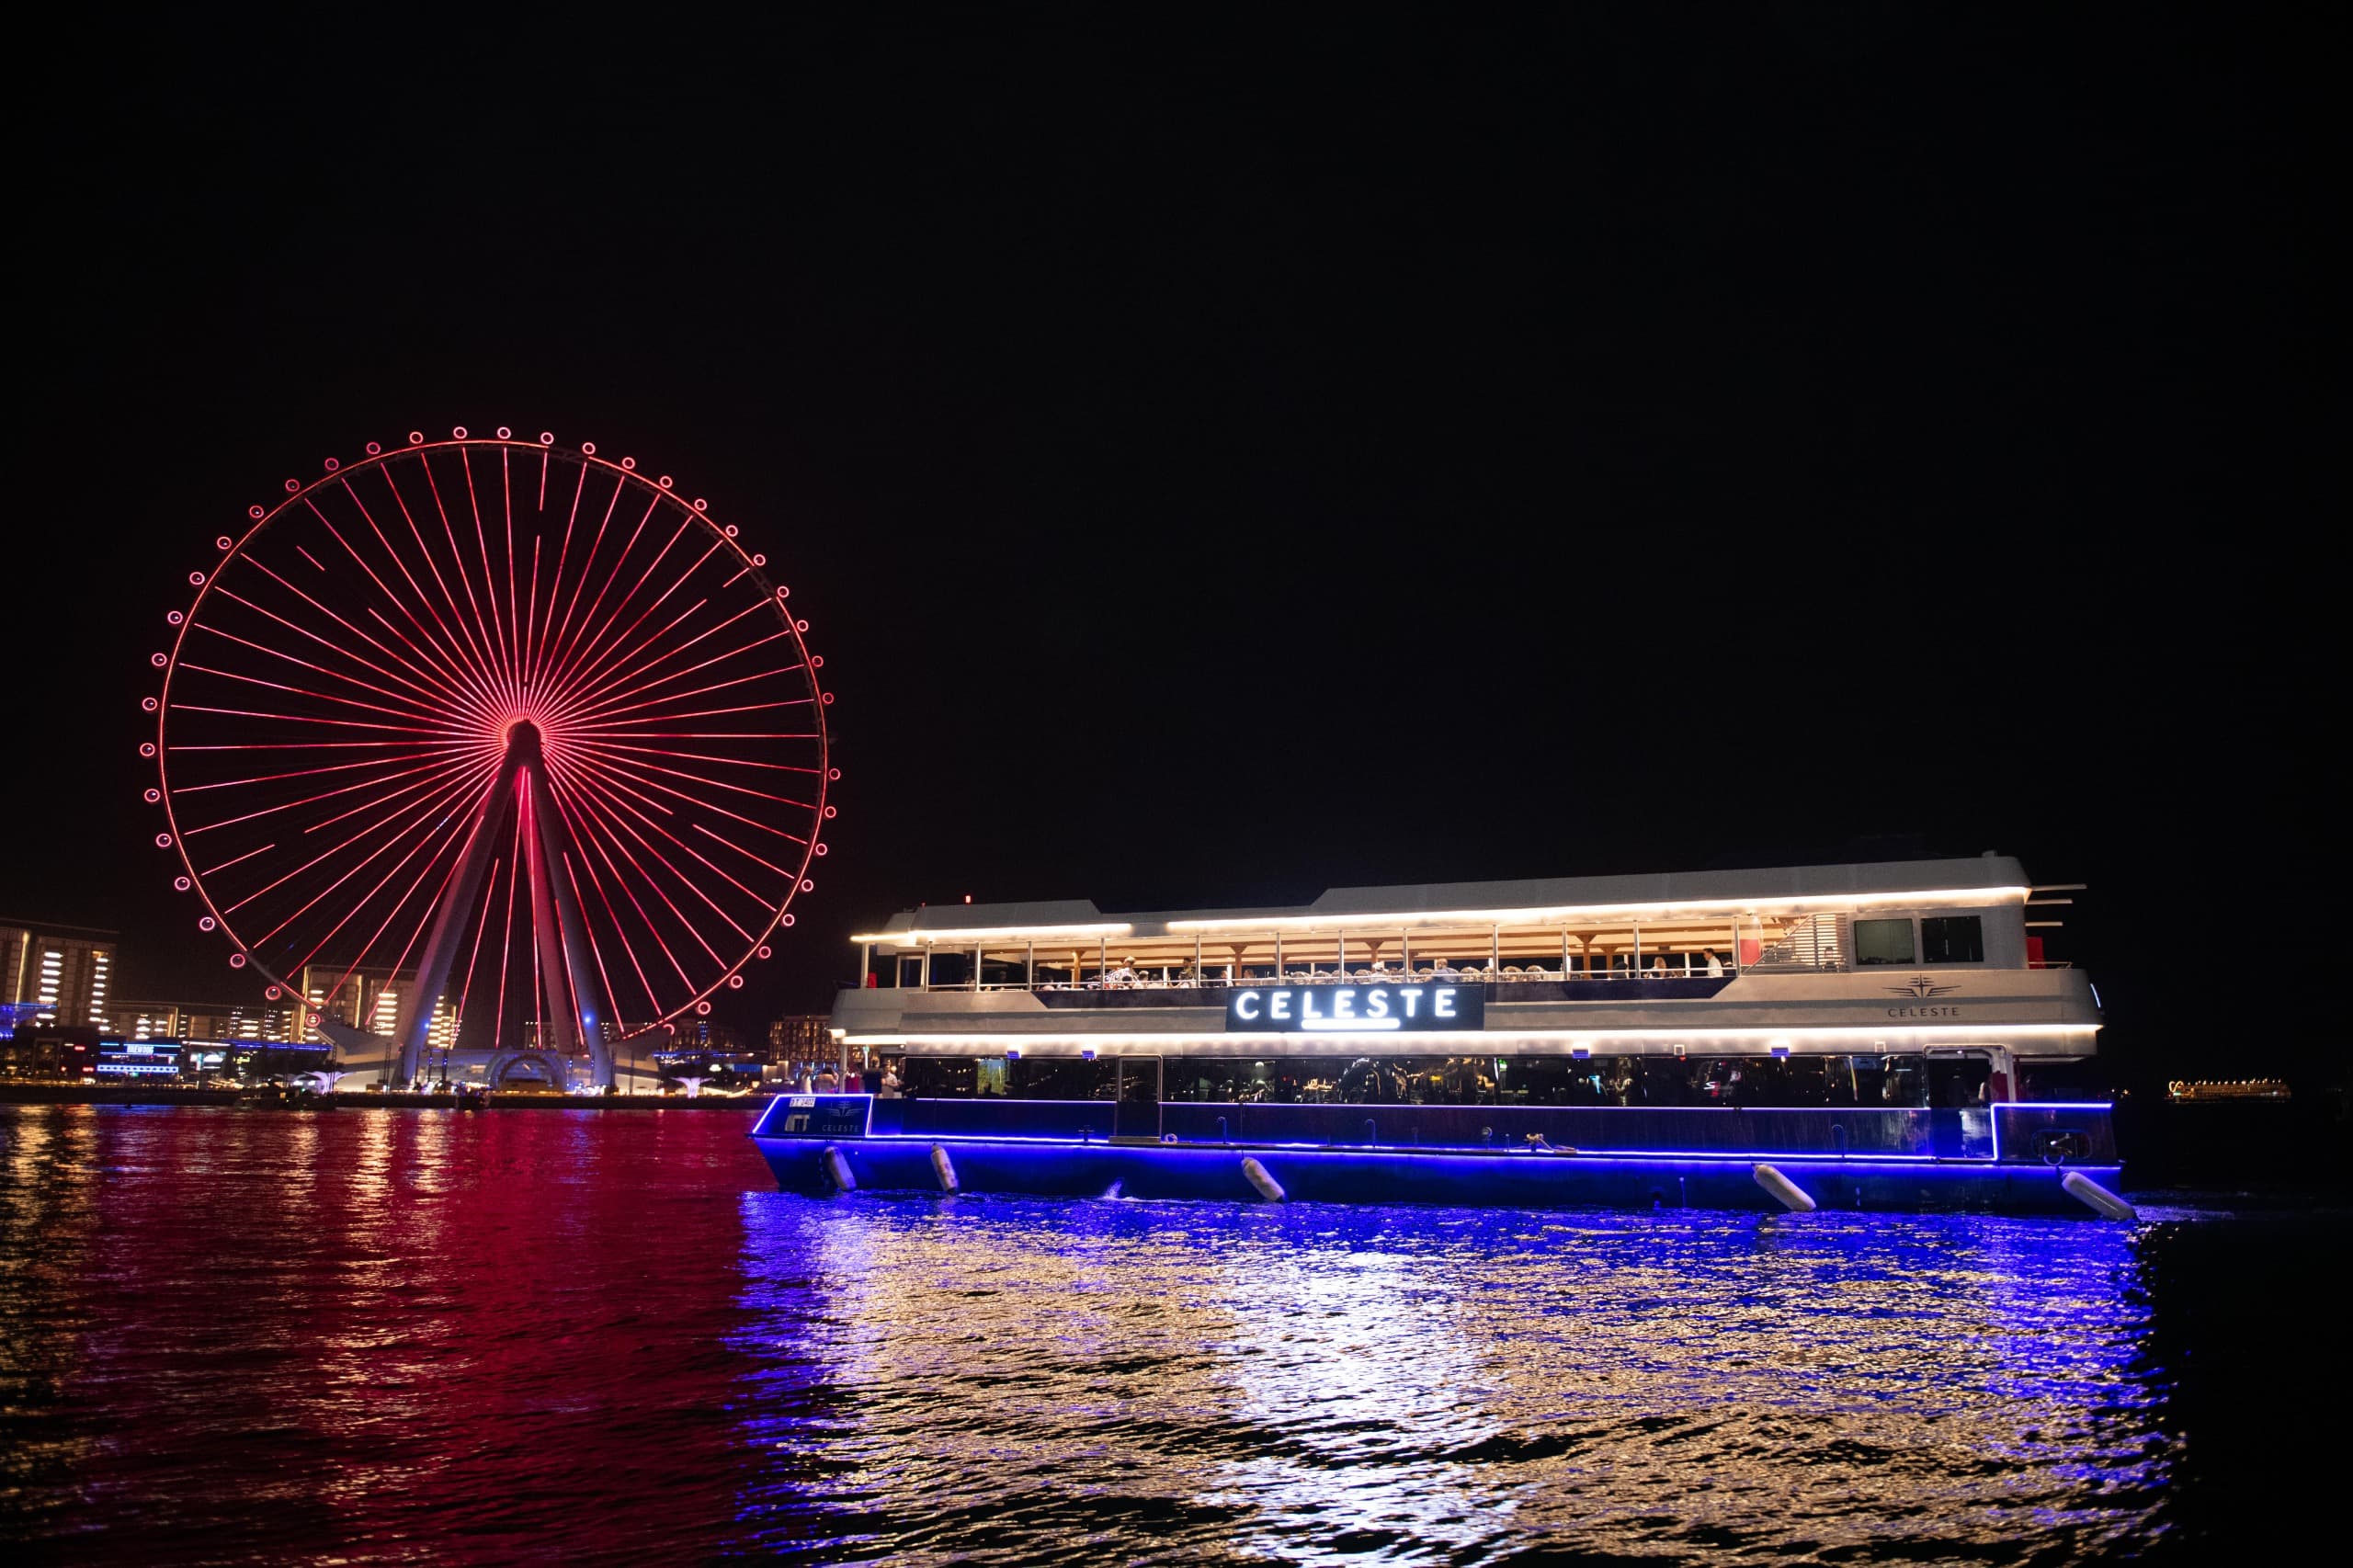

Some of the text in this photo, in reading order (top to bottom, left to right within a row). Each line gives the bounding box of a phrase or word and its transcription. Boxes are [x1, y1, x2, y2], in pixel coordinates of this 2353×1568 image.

[1236, 989, 1457, 1019] CELESTE
[1888, 1007, 1961, 1017] CELESTE
[822, 1124, 859, 1132] CELESTE
